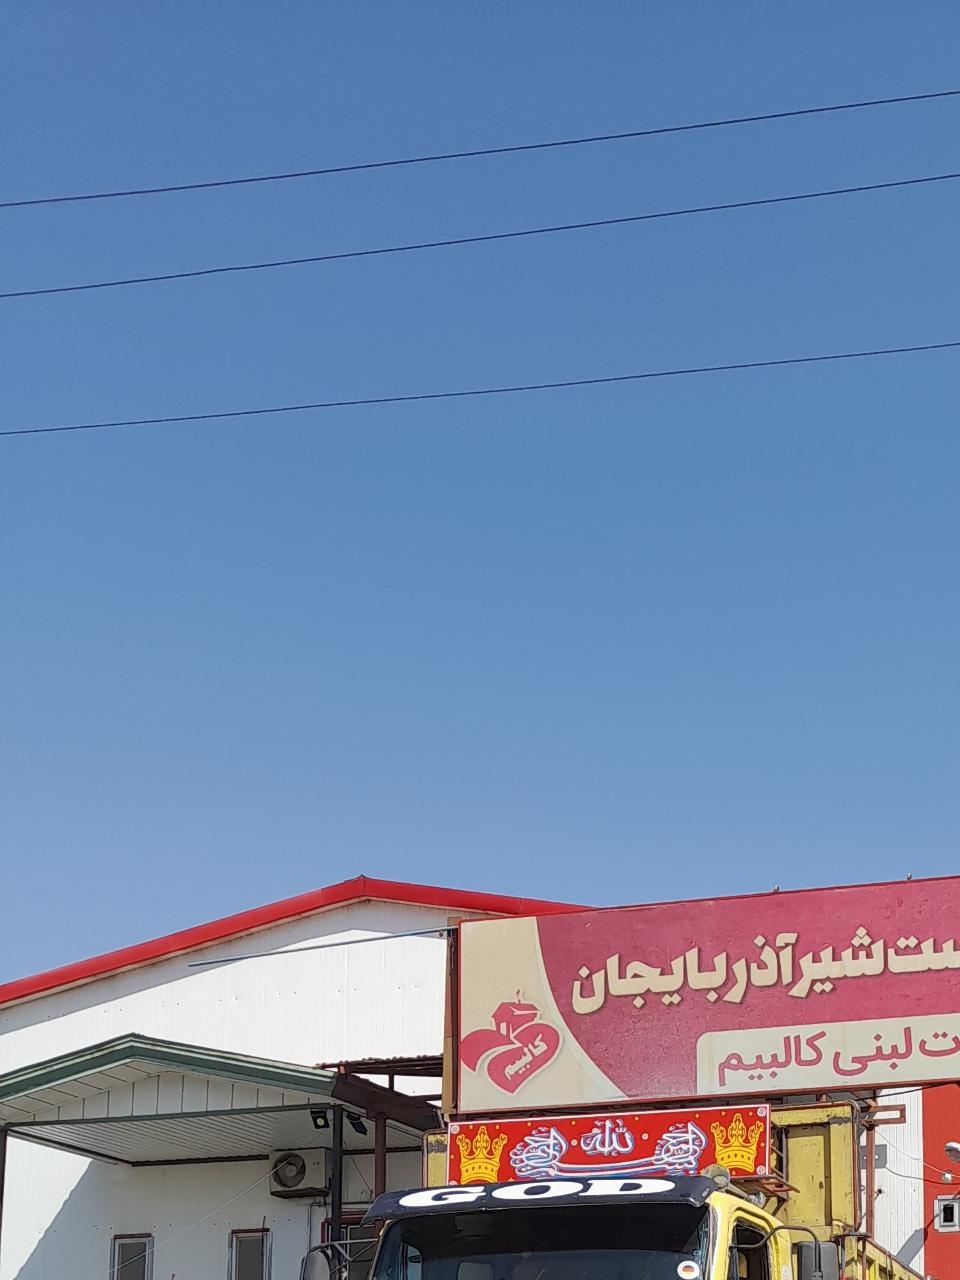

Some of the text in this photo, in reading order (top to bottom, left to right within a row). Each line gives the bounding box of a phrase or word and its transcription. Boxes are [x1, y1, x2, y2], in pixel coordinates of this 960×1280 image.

[571, 932, 798, 1014] آذربایجان
[788, 926, 884, 998] شیر
[717, 1032, 826, 1086] کالبیم
[833, 1026, 912, 1076] لبنی
[399, 1179, 676, 1207] GOD
